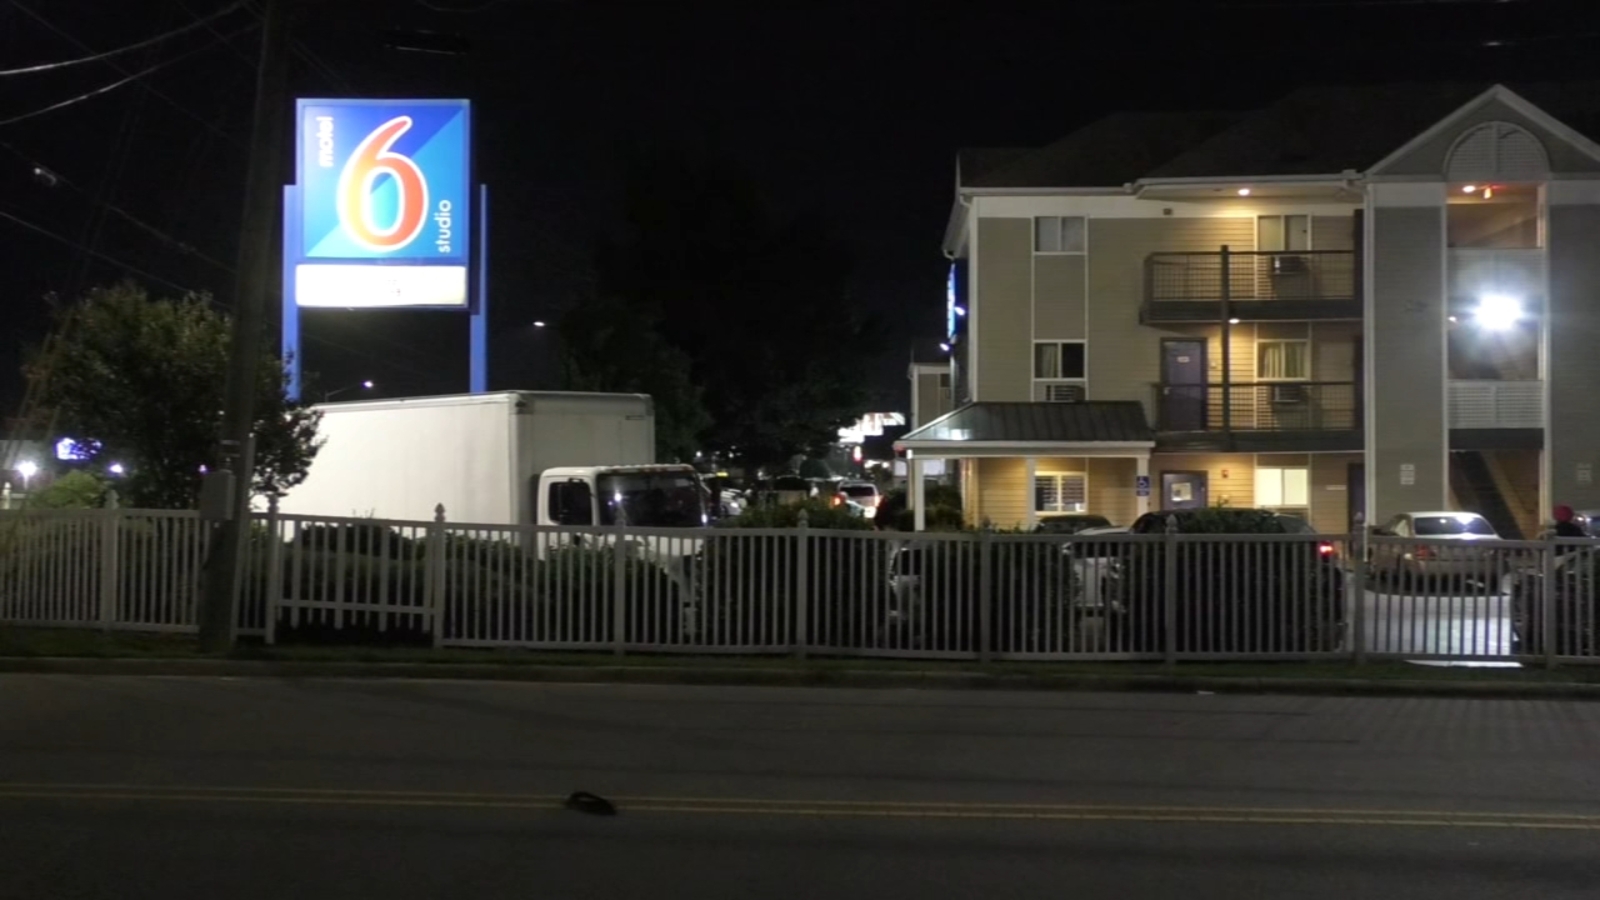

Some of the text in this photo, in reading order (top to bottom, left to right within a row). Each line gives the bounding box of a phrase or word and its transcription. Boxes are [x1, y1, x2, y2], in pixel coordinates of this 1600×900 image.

[316, 116, 334, 167] motel
[336, 115, 429, 253] 6
[434, 200, 452, 253] studio
